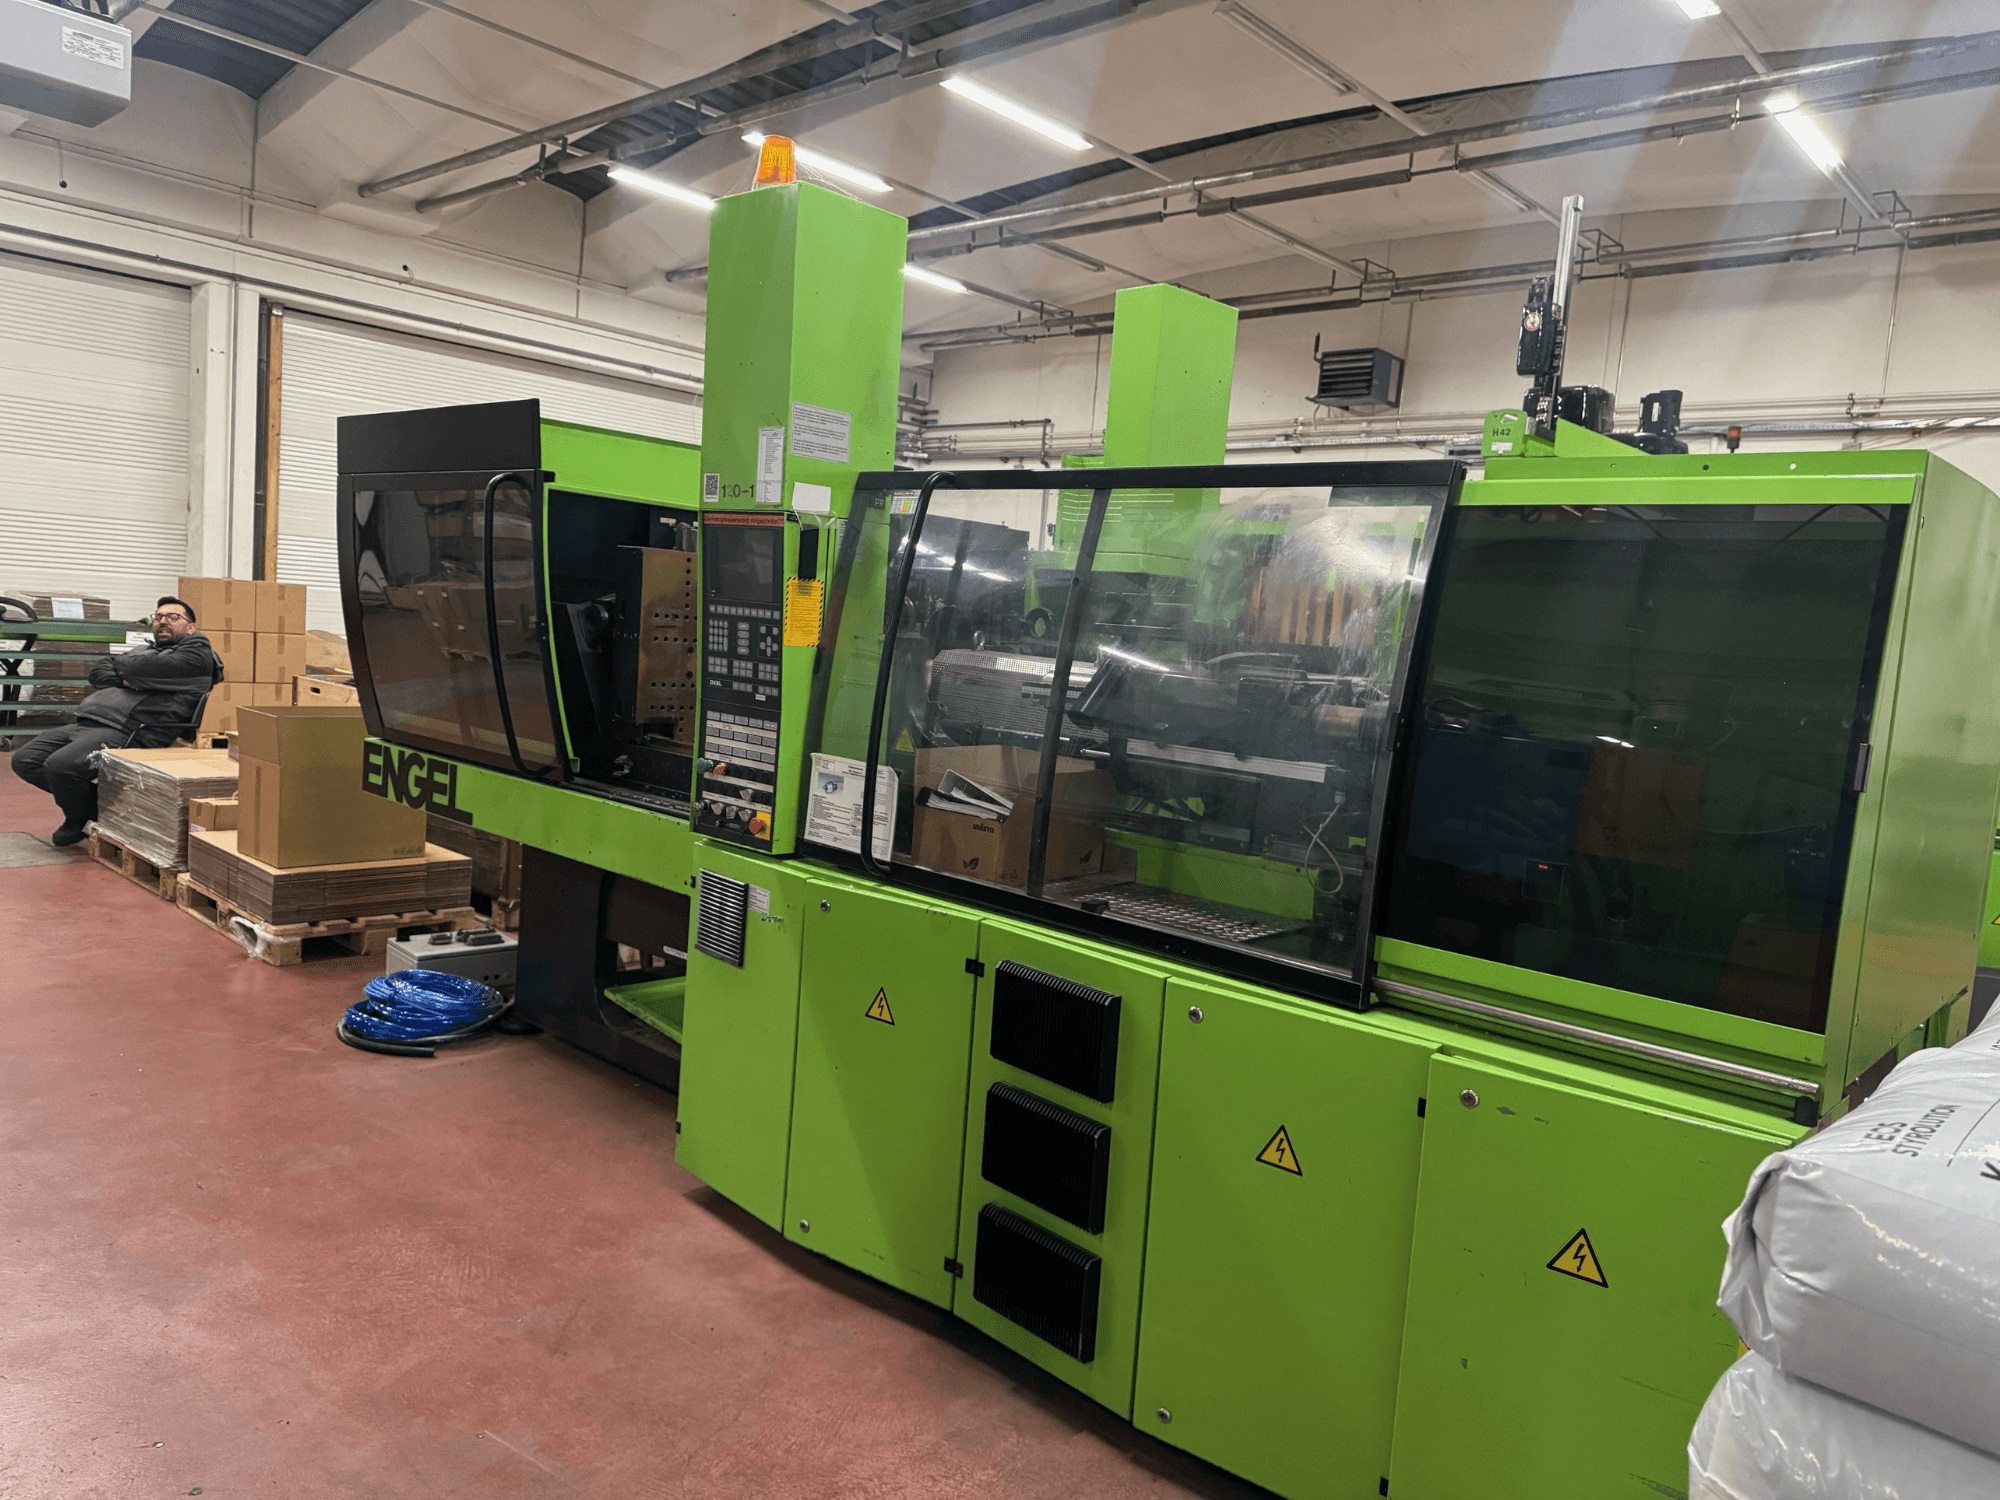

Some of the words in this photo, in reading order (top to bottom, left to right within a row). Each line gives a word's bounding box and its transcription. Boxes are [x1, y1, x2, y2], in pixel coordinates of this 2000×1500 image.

[1492, 428, 1511, 436] H42
[362, 741, 473, 826] ENGEL
[1863, 1122, 1908, 1143] EOS
[1891, 1104, 1962, 1157] STYROLUTION
